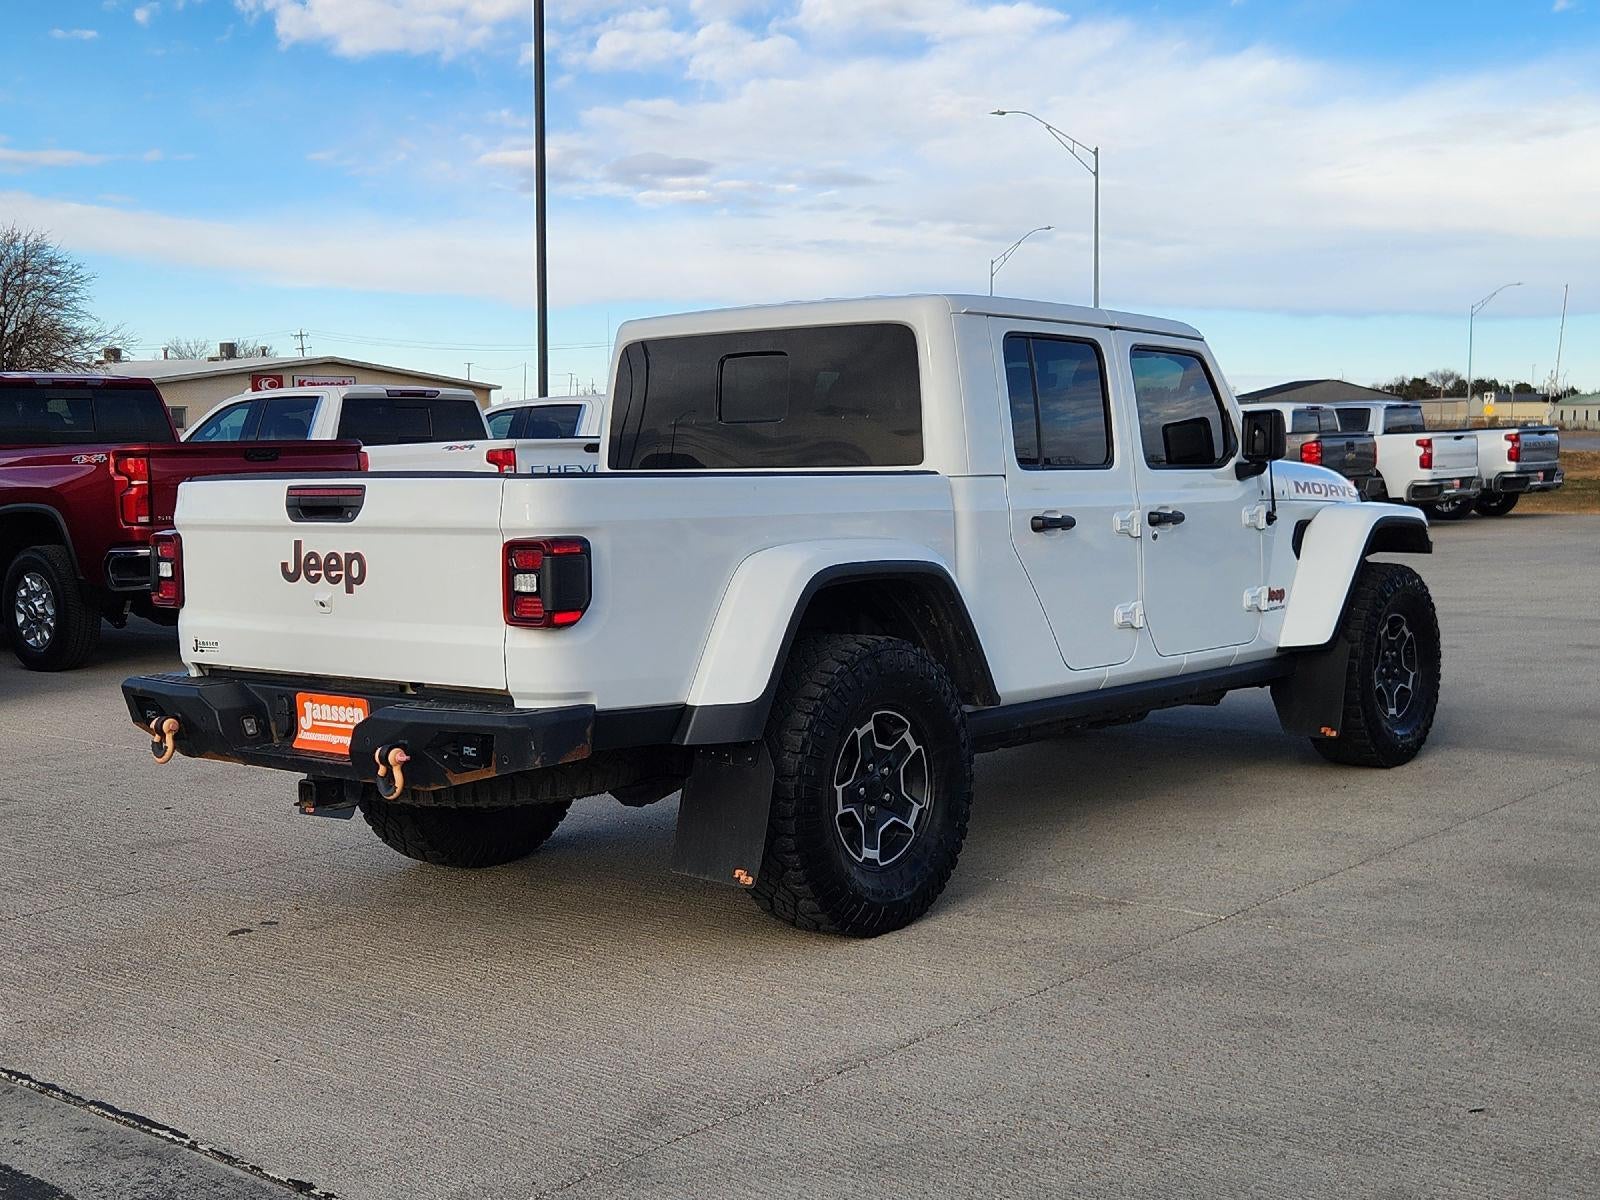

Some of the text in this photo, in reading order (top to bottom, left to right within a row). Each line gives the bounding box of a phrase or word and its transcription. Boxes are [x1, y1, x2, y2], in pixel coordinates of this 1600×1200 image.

[72, 454, 107, 464] 4x4
[1293, 481, 1358, 498] MOJAVE
[281, 540, 367, 594] Jeep
[301, 702, 364, 730] Janssen
